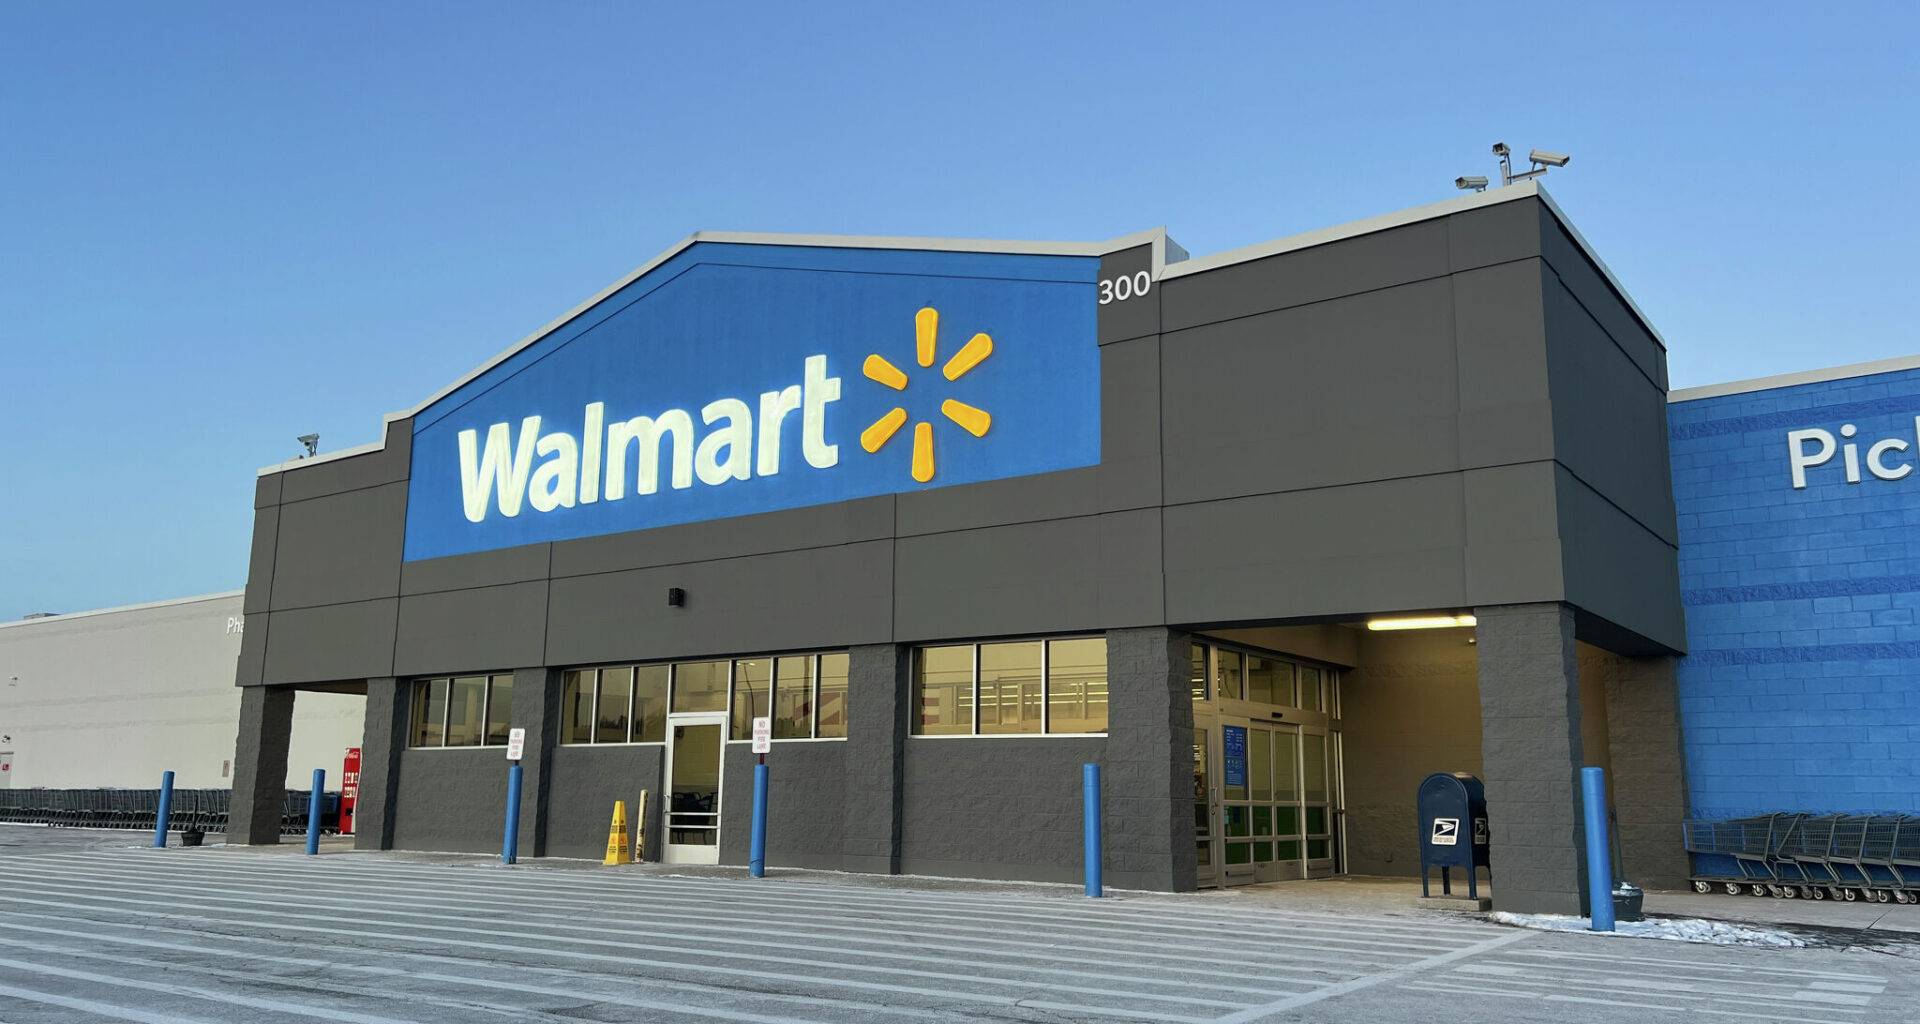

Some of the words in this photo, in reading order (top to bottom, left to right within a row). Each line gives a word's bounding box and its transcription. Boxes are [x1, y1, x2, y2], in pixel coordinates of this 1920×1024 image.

[1099, 271, 1150, 305] 300
[458, 354, 841, 523] Walmart
[1788, 415, 1920, 491] Pic
